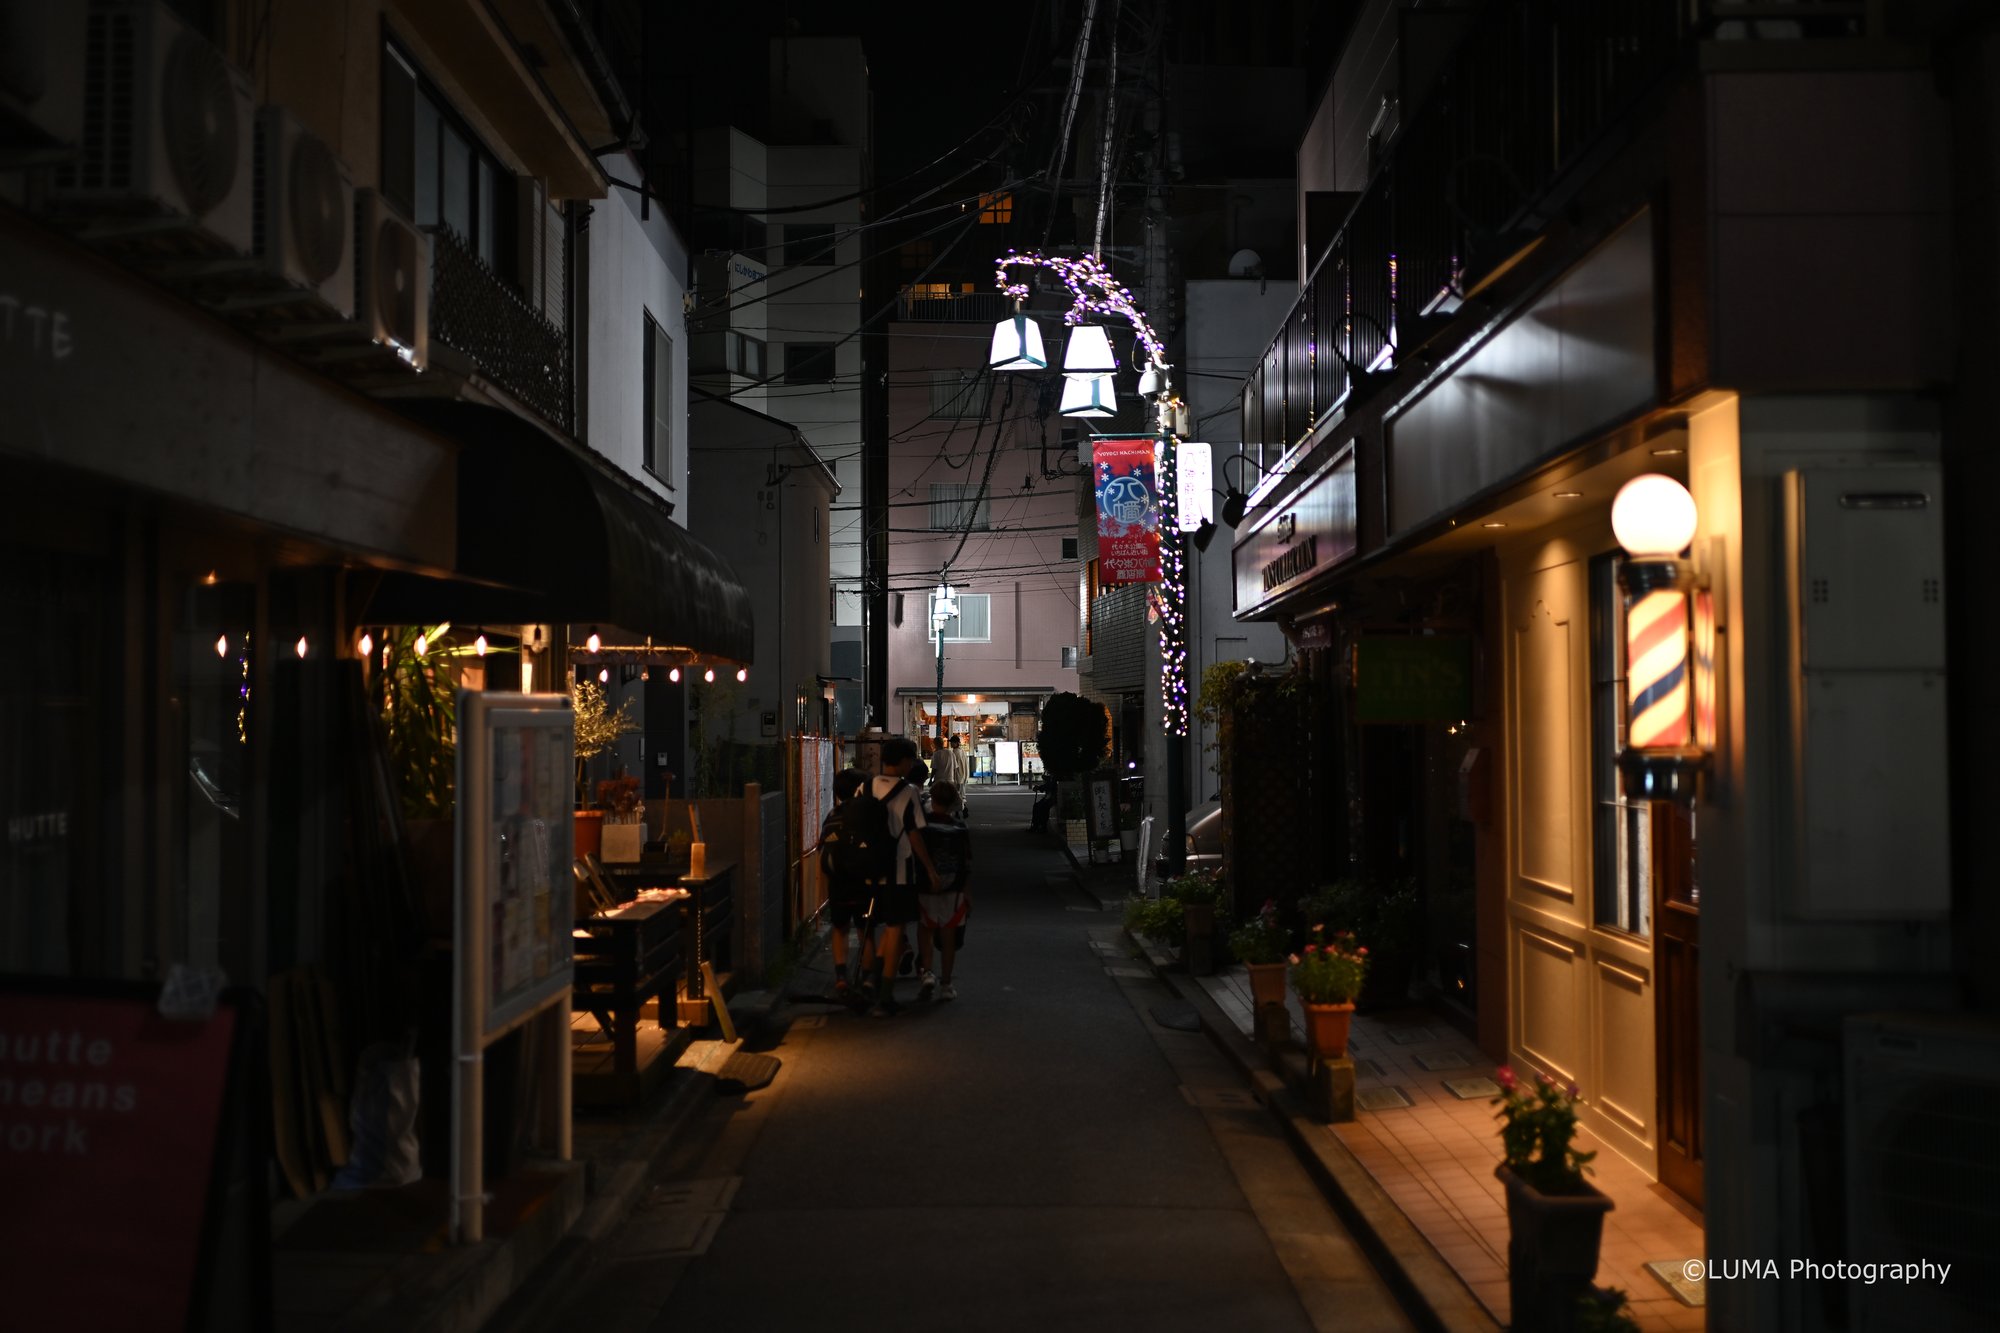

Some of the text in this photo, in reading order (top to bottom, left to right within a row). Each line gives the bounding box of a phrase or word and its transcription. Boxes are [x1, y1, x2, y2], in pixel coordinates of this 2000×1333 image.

[1111, 482, 1141, 521] 八幡
[8, 812, 68, 842] HUTTE
[0, 1117, 88, 1155] ork
